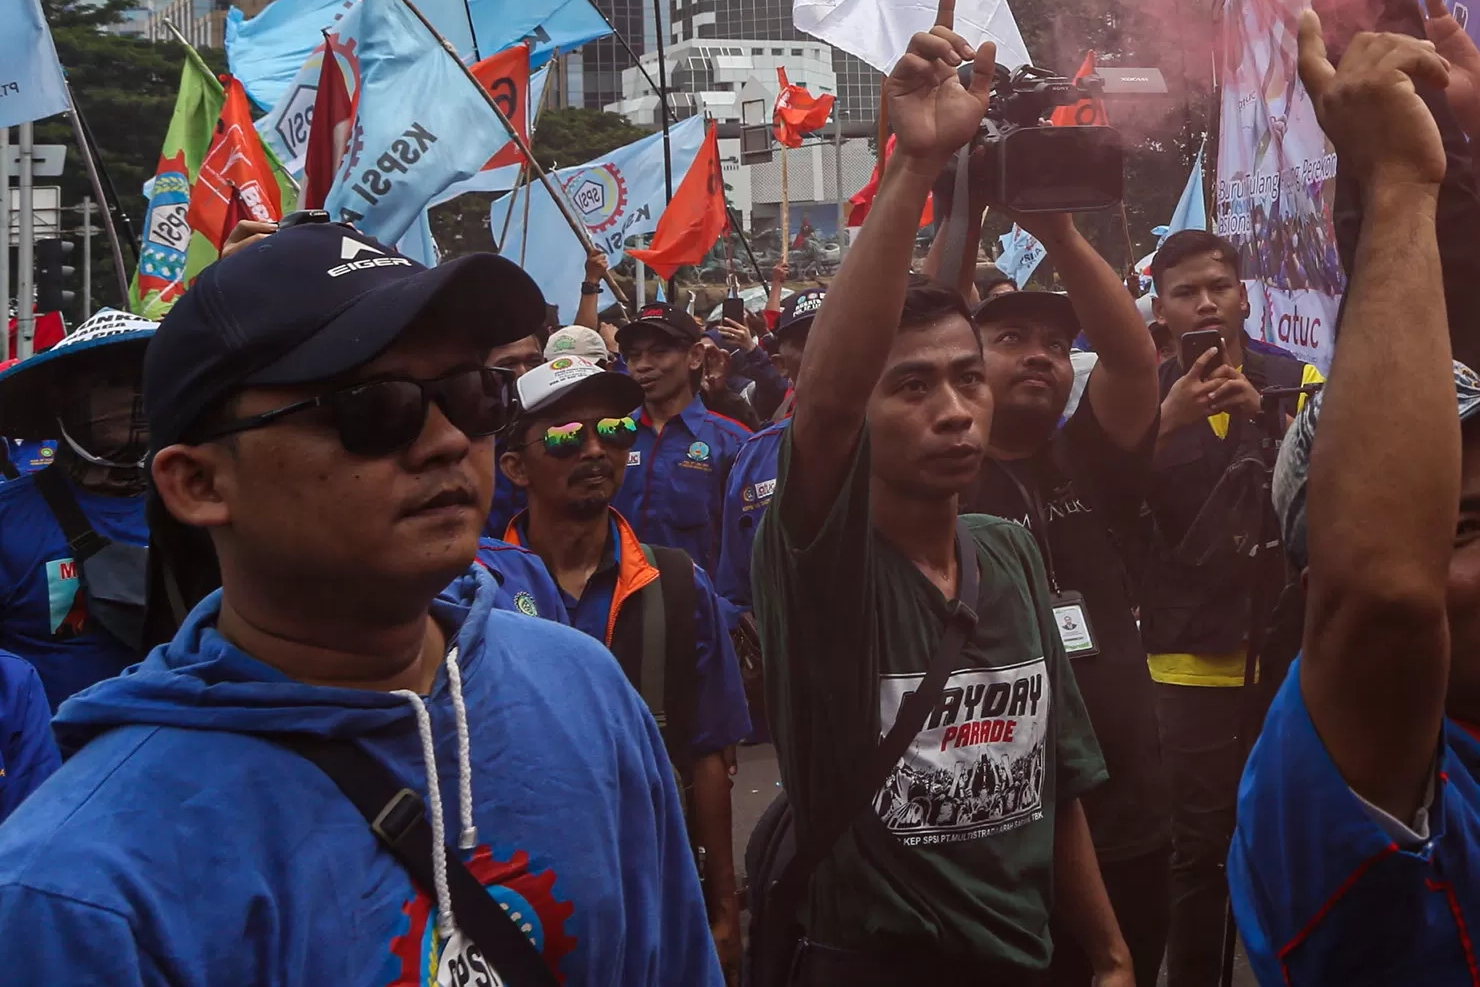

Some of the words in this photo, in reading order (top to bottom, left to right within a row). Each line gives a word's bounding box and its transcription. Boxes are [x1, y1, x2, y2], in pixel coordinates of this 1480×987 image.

[327, 258, 412, 278] EIGER
[1278, 311, 1321, 349] atuc
[941, 719, 1017, 752] PARADE
[903, 836, 921, 846] KEP
